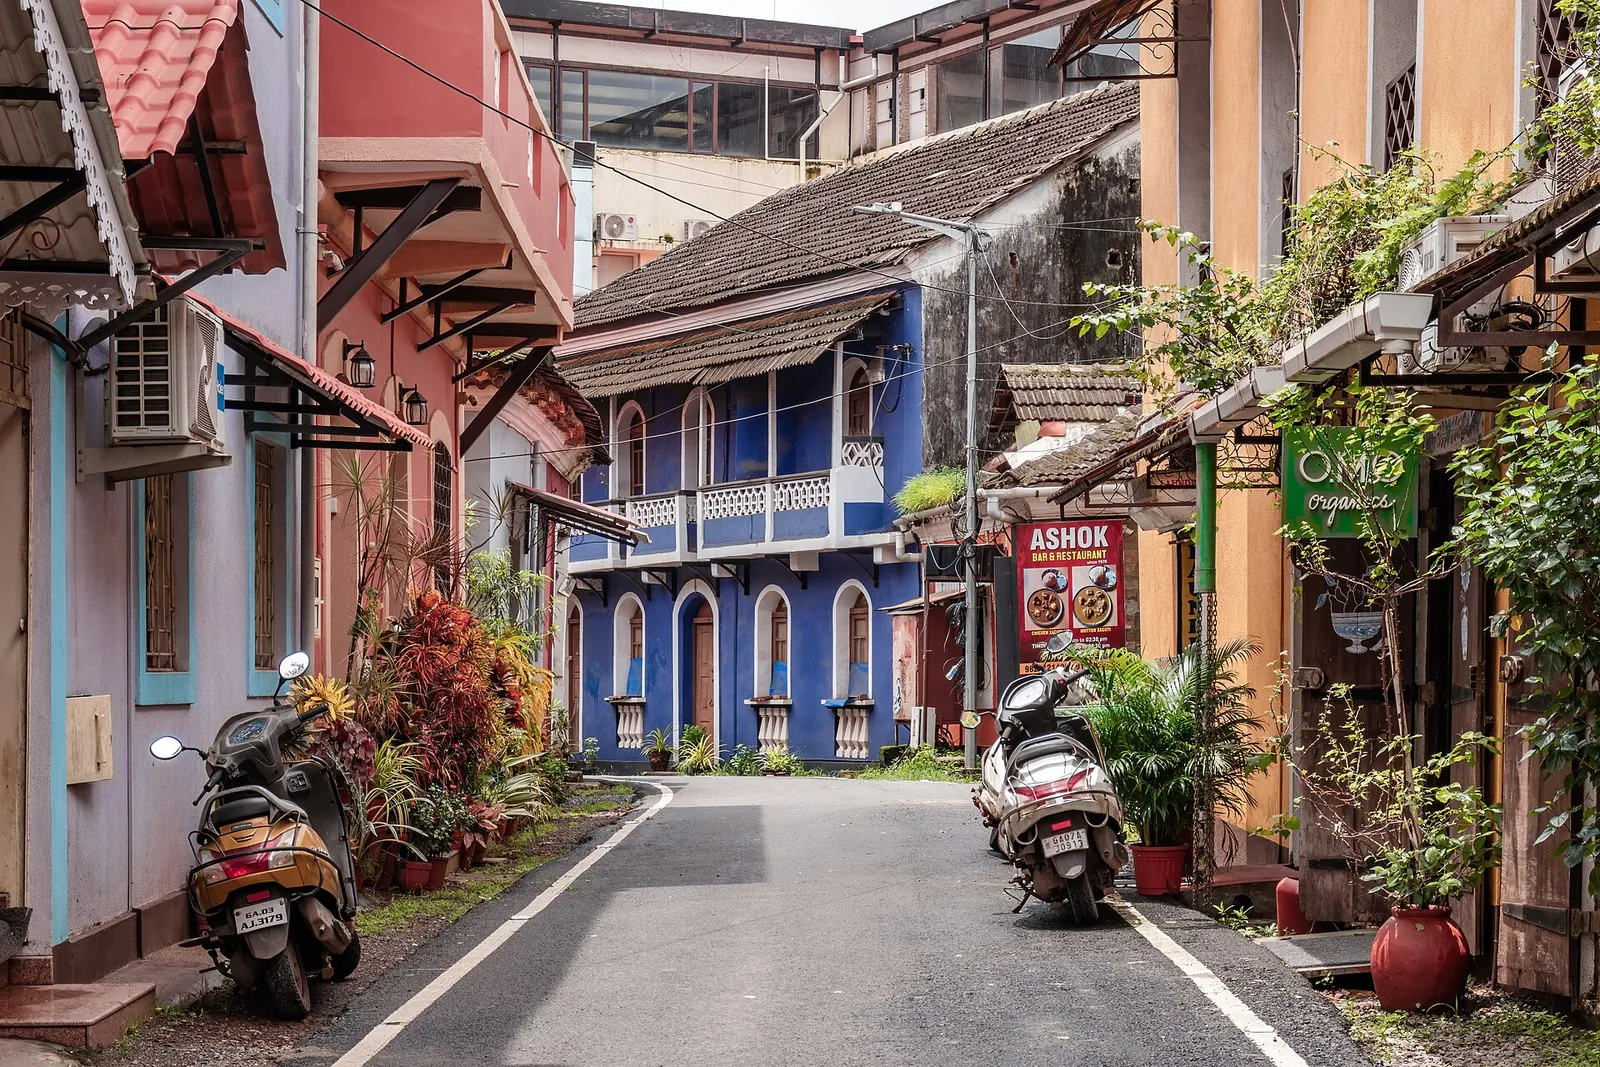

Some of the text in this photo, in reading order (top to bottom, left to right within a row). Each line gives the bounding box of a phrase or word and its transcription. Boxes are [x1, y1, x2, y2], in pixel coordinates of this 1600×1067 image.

[1029, 525, 1109, 550] ASHOK
[1032, 550, 1107, 562] BAR & RESTAURANT
[1052, 832, 1082, 844] GA07A
[1055, 840, 1084, 852] J0913
[240, 914, 283, 931] AJ.3179
